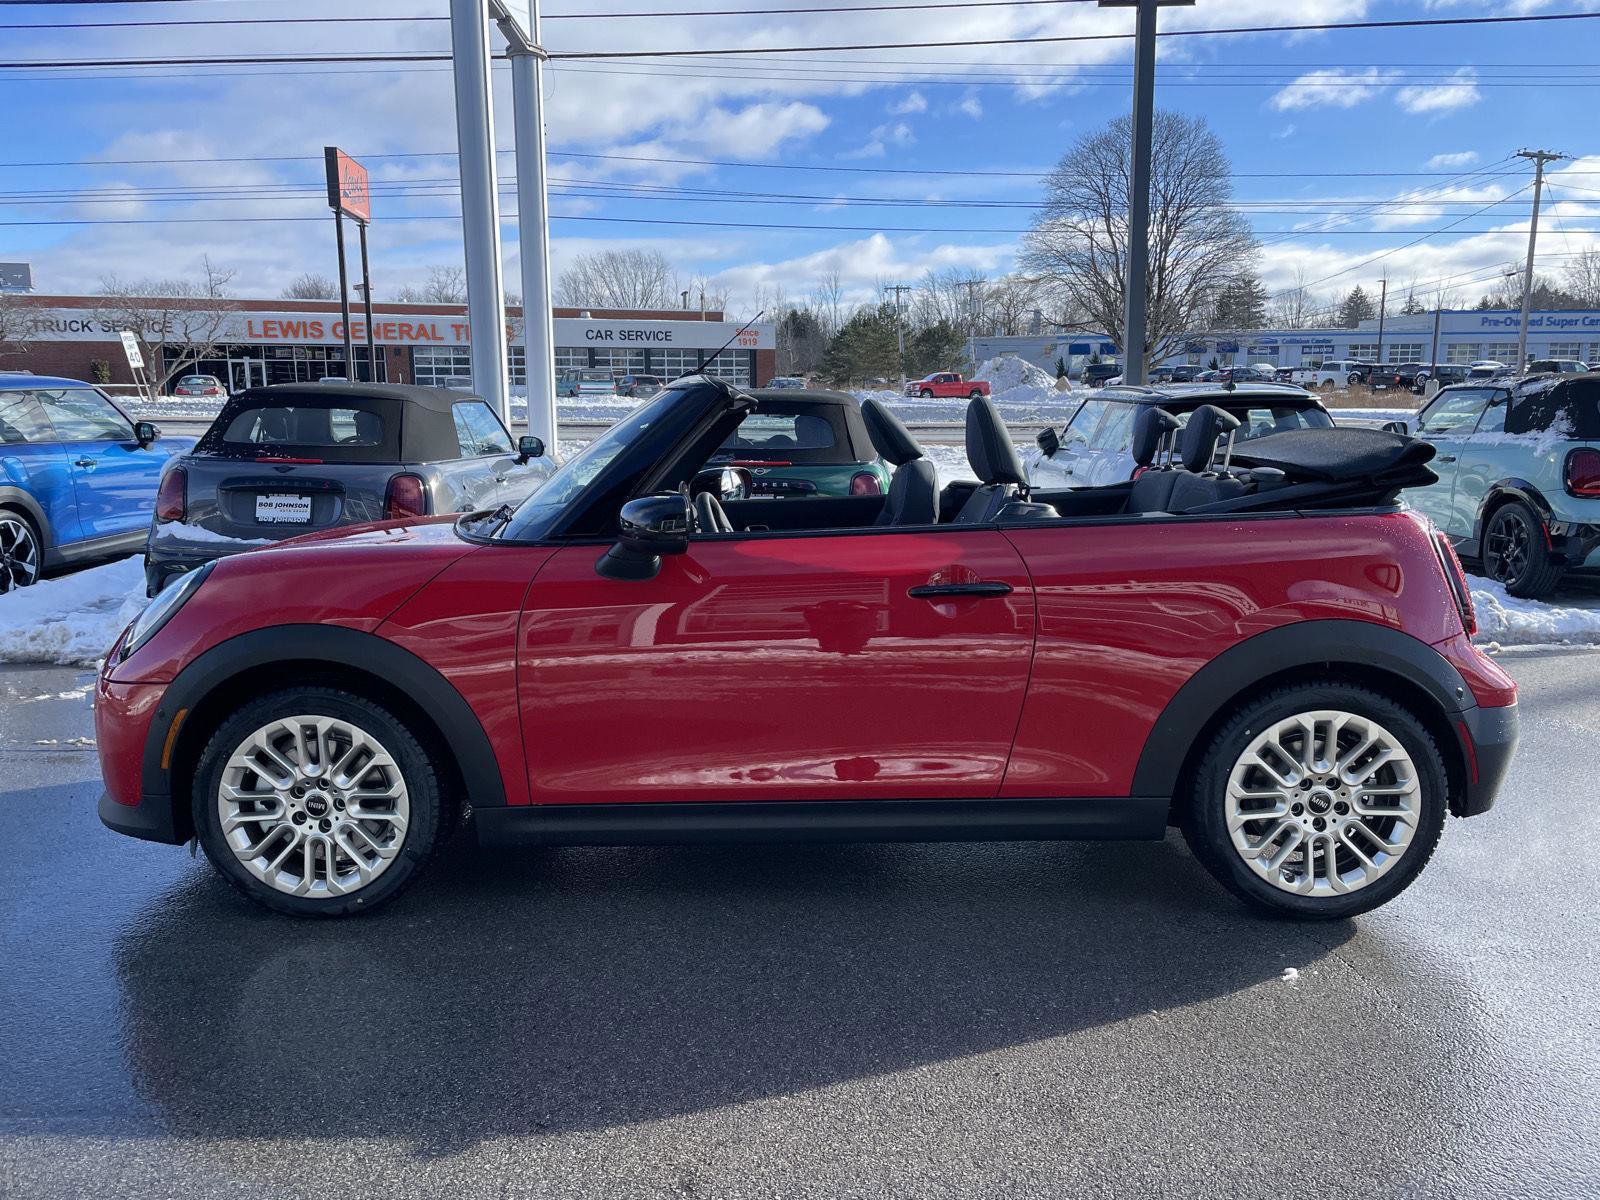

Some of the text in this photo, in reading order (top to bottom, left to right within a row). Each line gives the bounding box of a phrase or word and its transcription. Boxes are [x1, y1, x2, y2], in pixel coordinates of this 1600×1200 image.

[29, 319, 94, 333] TRUCK
[1481, 316, 1543, 327] Pre-Owed
[1545, 316, 1580, 329] Super
[247, 320, 324, 340] LEWIS
[585, 329, 673, 342] CAR SERVICE
[735, 327, 760, 337] Since
[737, 338, 758, 347] 1919
[129, 352, 141, 363] 40
